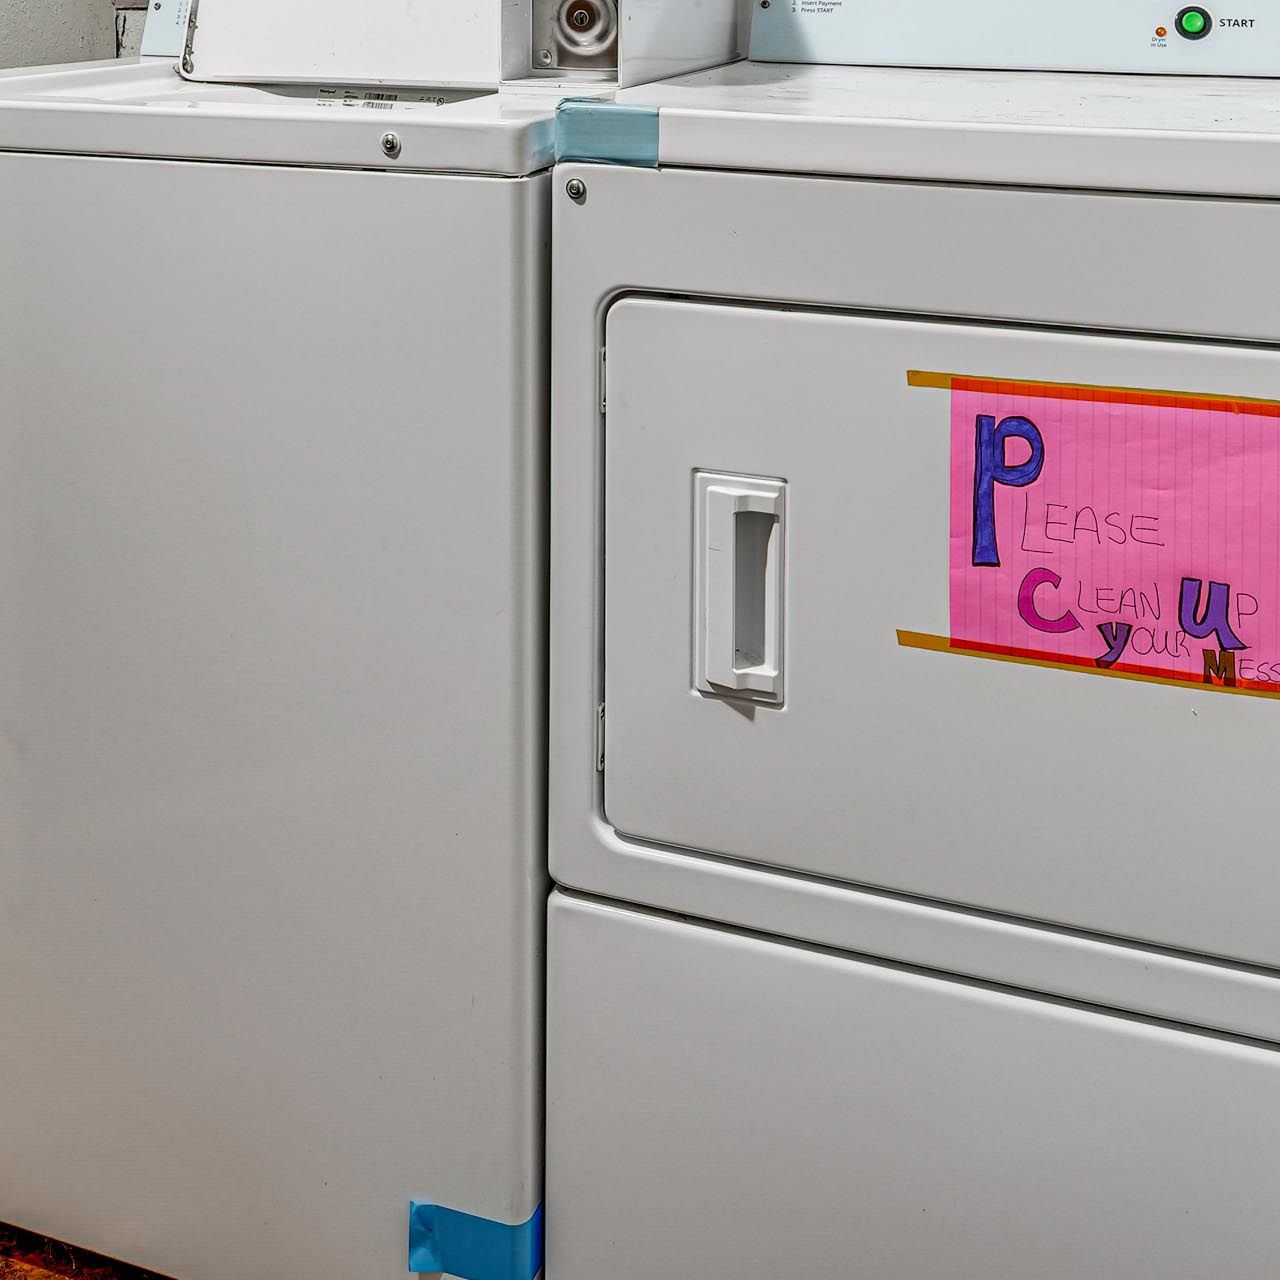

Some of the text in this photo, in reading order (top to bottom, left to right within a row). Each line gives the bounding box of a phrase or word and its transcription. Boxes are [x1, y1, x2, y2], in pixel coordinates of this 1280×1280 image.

[1220, 19, 1255, 28] START
[972, 414, 1164, 566] PLEASE
[1018, 567, 1161, 633] CLEAN
